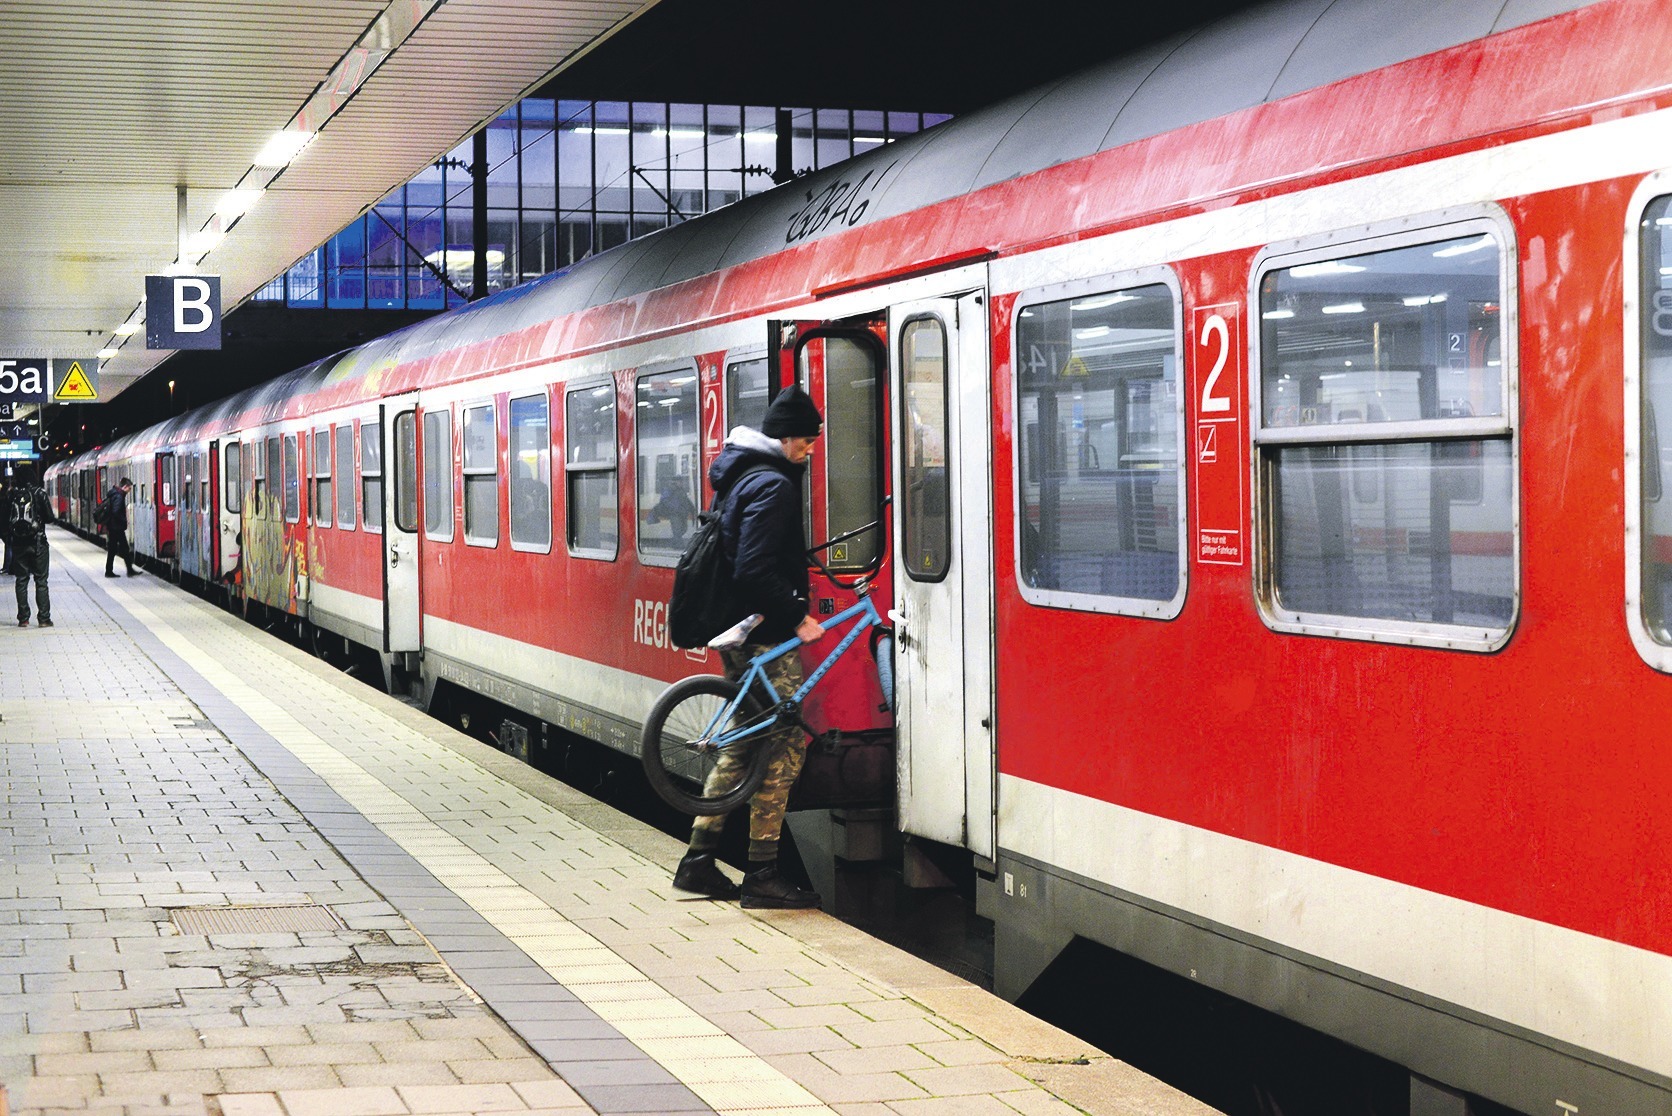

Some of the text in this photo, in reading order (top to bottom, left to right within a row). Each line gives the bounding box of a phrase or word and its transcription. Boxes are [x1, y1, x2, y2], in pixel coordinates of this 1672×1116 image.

[173, 278, 214, 333] B
[1200, 314, 1231, 413] 2
[1450, 334, 1461, 352] 2
[0, 360, 42, 394] 5a
[0, 404, 10, 415] a
[706, 389, 718, 448] 2
[38, 435, 50, 451] C
[633, 598, 679, 652] REGI
